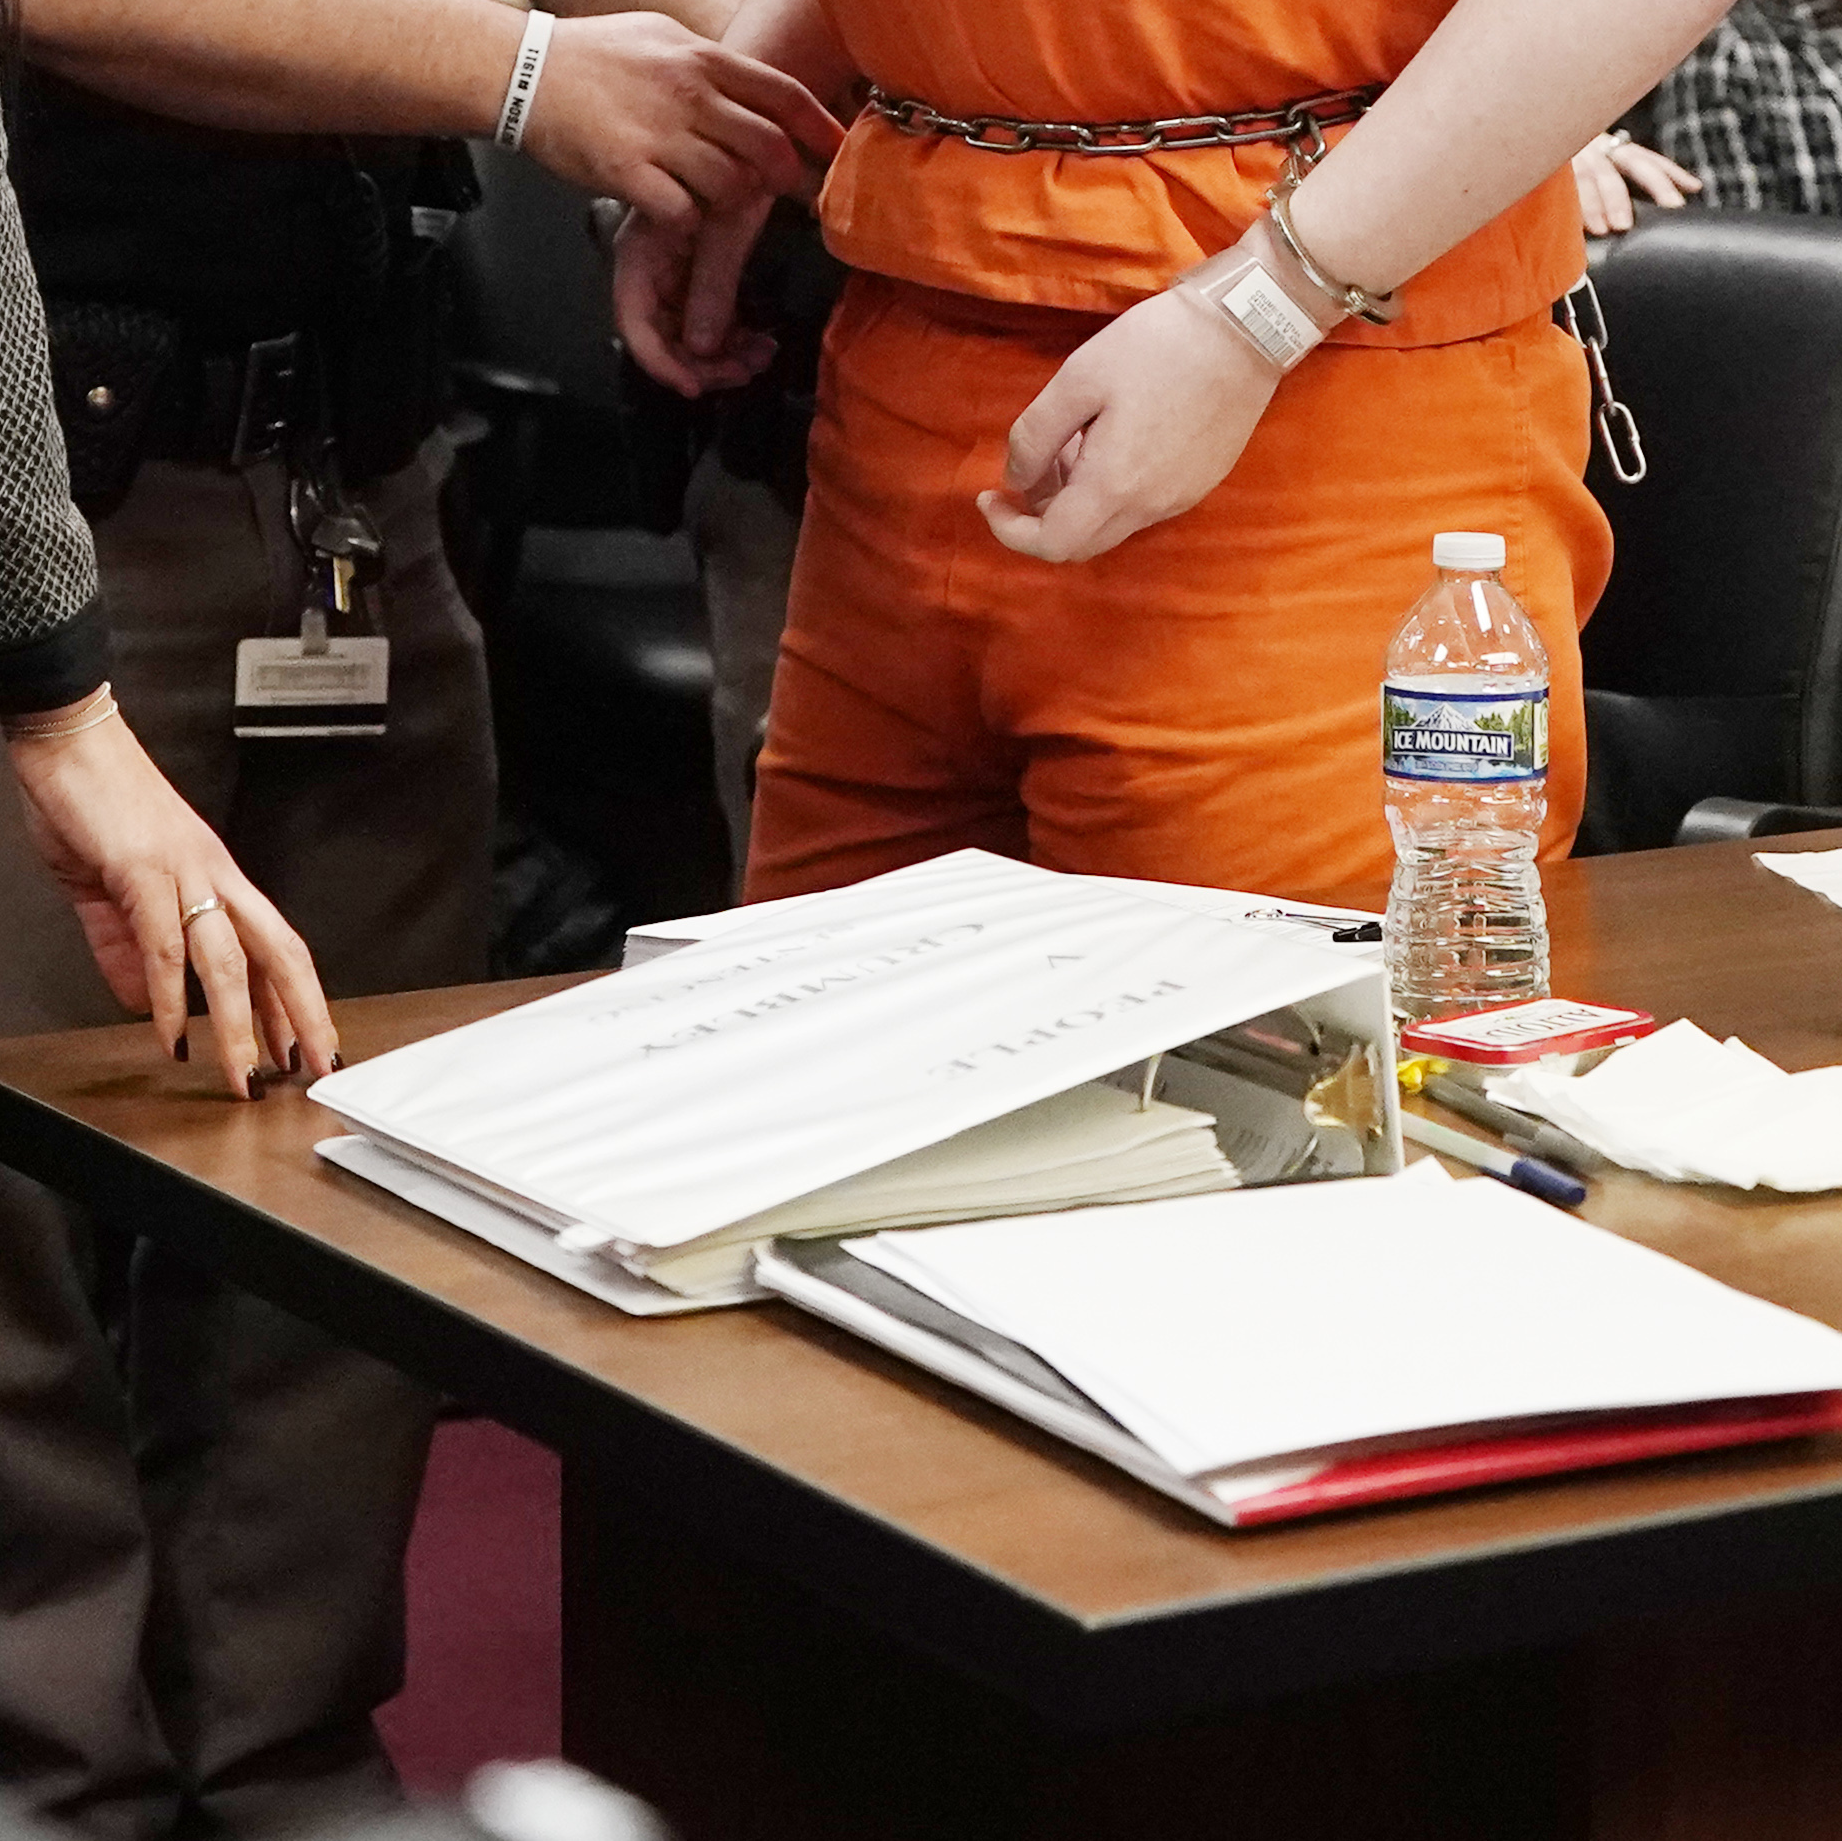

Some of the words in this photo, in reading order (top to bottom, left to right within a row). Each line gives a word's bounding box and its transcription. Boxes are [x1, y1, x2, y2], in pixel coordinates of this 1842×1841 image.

[1394, 730, 1414, 749] ICE
[1415, 730, 1508, 755] MOUNTAIN
[639, 923, 985, 1059] CRUMBLEY
[1046, 954, 1087, 970] V
[927, 979, 1187, 1084] PEOPLE
